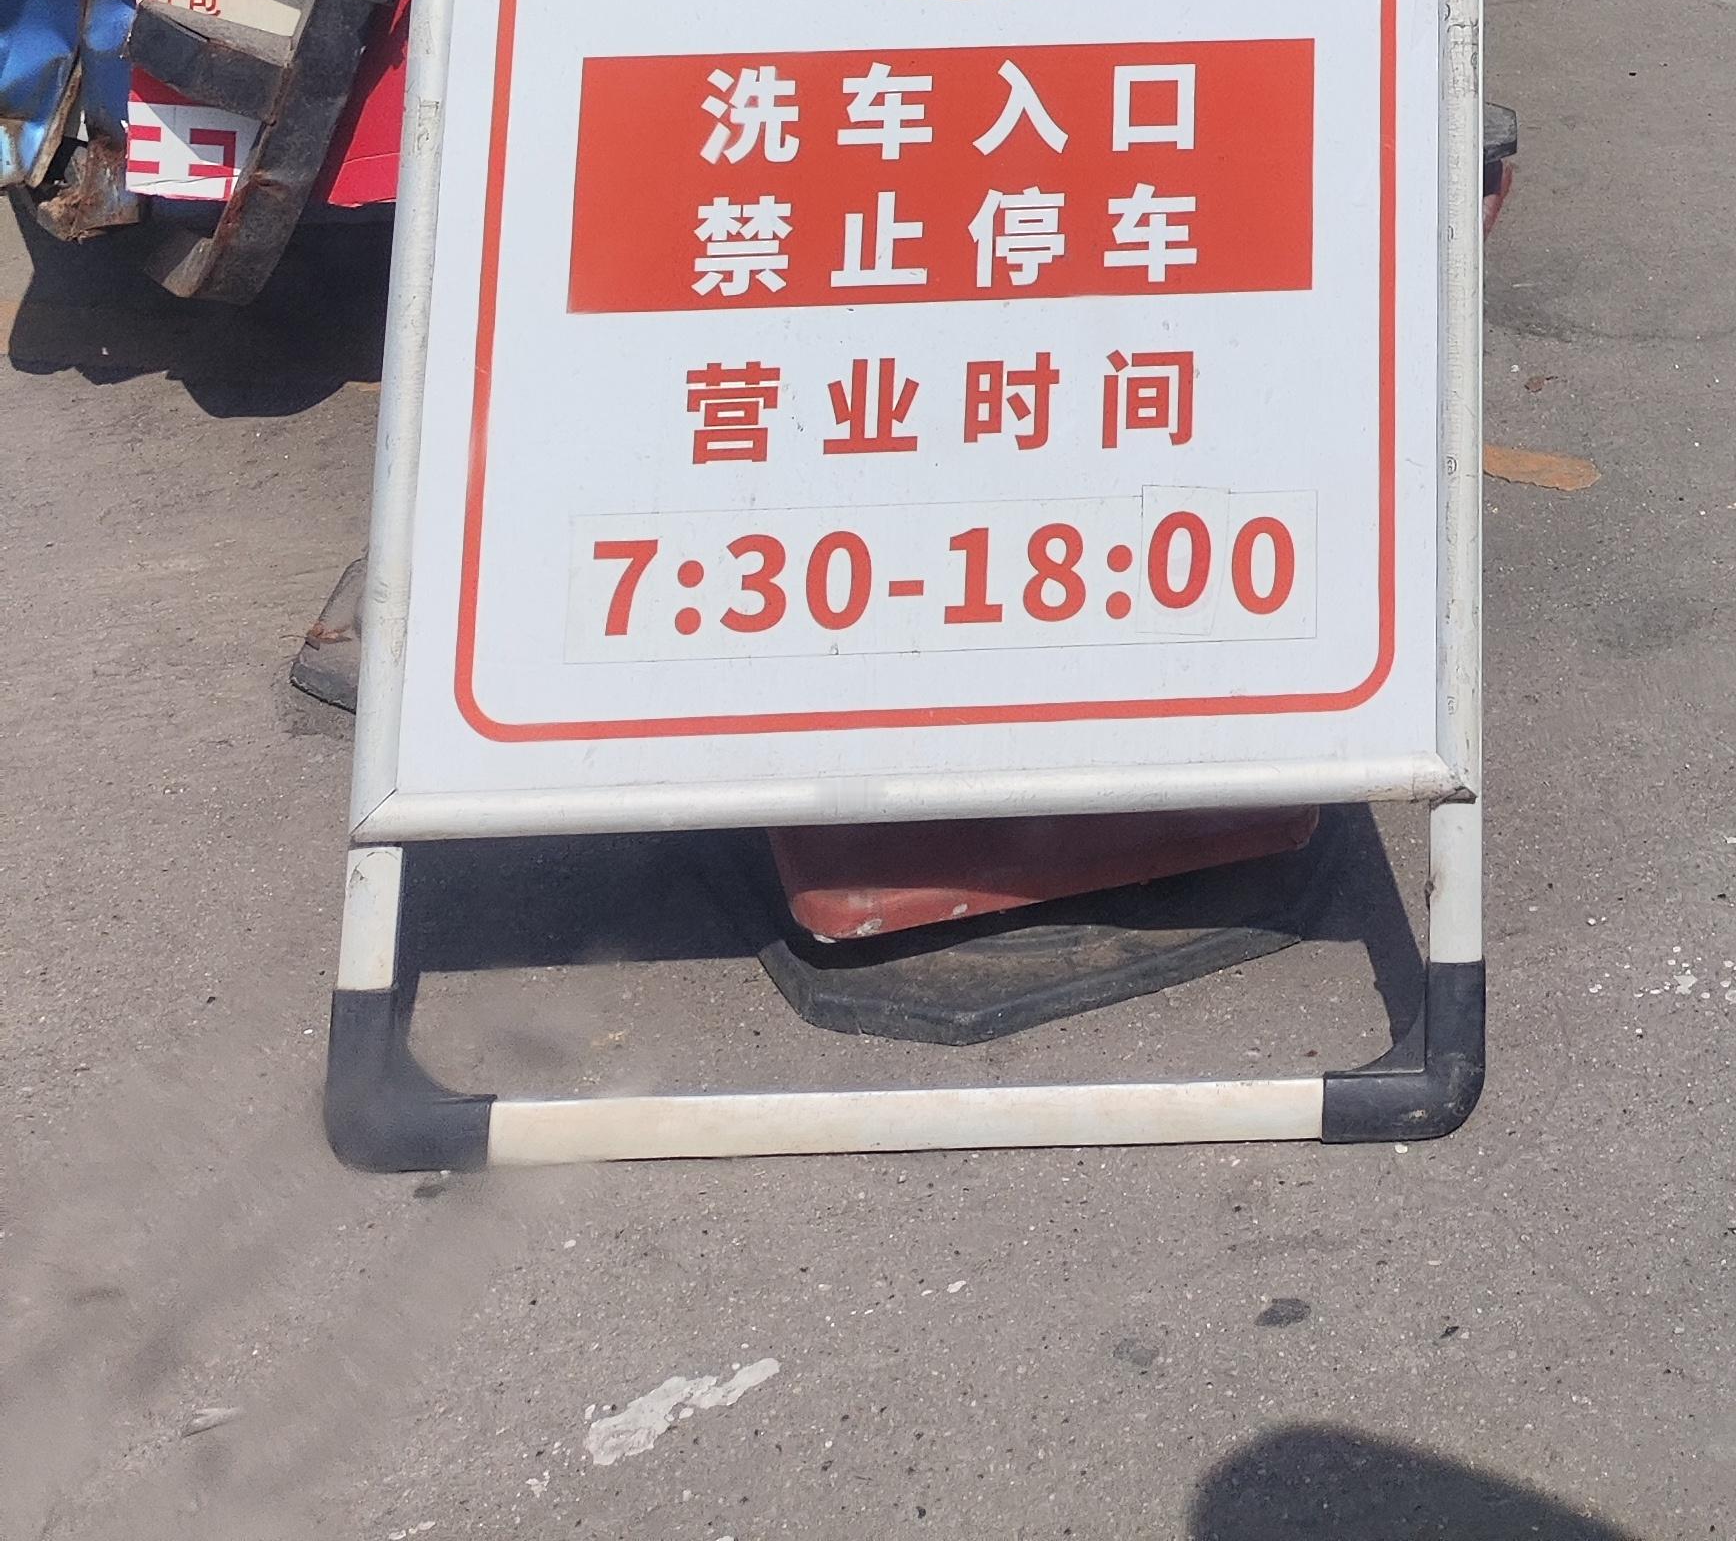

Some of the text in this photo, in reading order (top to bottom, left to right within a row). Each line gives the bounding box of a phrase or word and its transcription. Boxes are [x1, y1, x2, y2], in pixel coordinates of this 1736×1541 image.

[698, 59, 1198, 166] 洗车入口
[690, 182, 1198, 298] 禁止停车
[683, 349, 1197, 466] 营业时间
[590, 509, 1297, 637] 7:30-18:00
